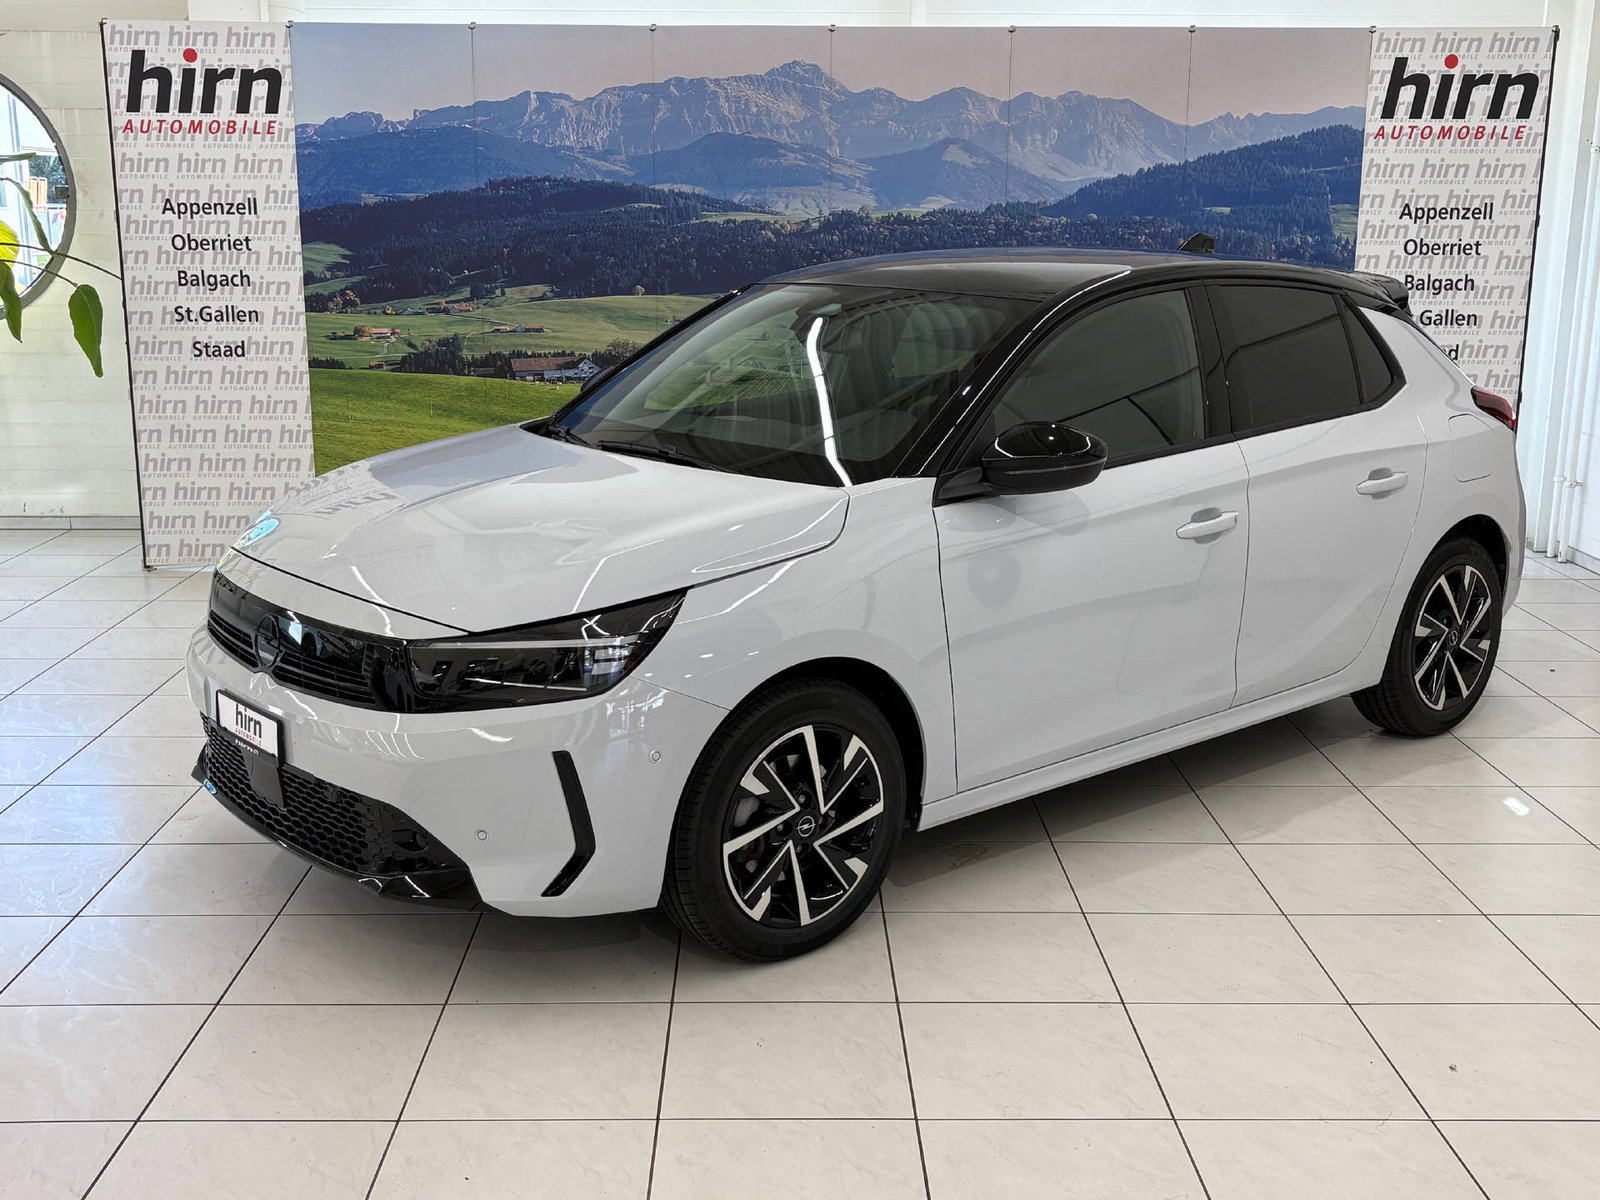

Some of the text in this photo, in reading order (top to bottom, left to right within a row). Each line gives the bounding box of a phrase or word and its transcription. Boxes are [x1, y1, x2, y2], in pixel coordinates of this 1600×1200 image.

[109, 25, 159, 46] hirn
[167, 25, 217, 46] hirn
[225, 26, 275, 46] hirn
[1376, 31, 1426, 52] hirn
[1432, 31, 1483, 52] hirn
[1488, 31, 1539, 52] hirn
[126, 48, 282, 114] hirn
[1380, 54, 1540, 119] hirn
[122, 119, 277, 135] AUTOMOBILE
[1374, 126, 1526, 140] AUTOMOBILE
[119, 152, 168, 172] hirn
[176, 152, 225, 172] hirn
[233, 153, 282, 173] hirn
[1366, 158, 1416, 177] hirn
[1421, 158, 1471, 178] hirn
[1476, 158, 1526, 178] hirn
[162, 198, 258, 219] Appenzell
[1400, 203, 1494, 224] Appenzell
[124, 214, 173, 234] hirn
[1362, 219, 1410, 238] hirn
[171, 234, 252, 250] Oberriet
[1403, 238, 1482, 256] Oberriet
[129, 275, 178, 294] hirn
[177, 270, 251, 291] Balgach
[1405, 274, 1475, 295] Balgach
[174, 304, 260, 323] St.Gallen
[1420, 309, 1477, 326] Gallen
[134, 335, 182, 354] hirn
[246, 335, 293, 354] hirn
[192, 340, 246, 358] Staad
[1459, 339, 1508, 358] hirn
[165, 365, 212, 384] hirn
[220, 365, 268, 384] hirn
[139, 394, 186, 413] hirn
[194, 394, 242, 413] hirn
[250, 394, 297, 413] hirn
[169, 424, 217, 442] hirn
[224, 424, 272, 442] hirn
[144, 452, 191, 471] hirn
[199, 452, 246, 471] hirn
[254, 452, 300, 471] hirn
[174, 481, 221, 500] hirn
[228, 481, 275, 500] hirn
[236, 703, 262, 738] hirn
